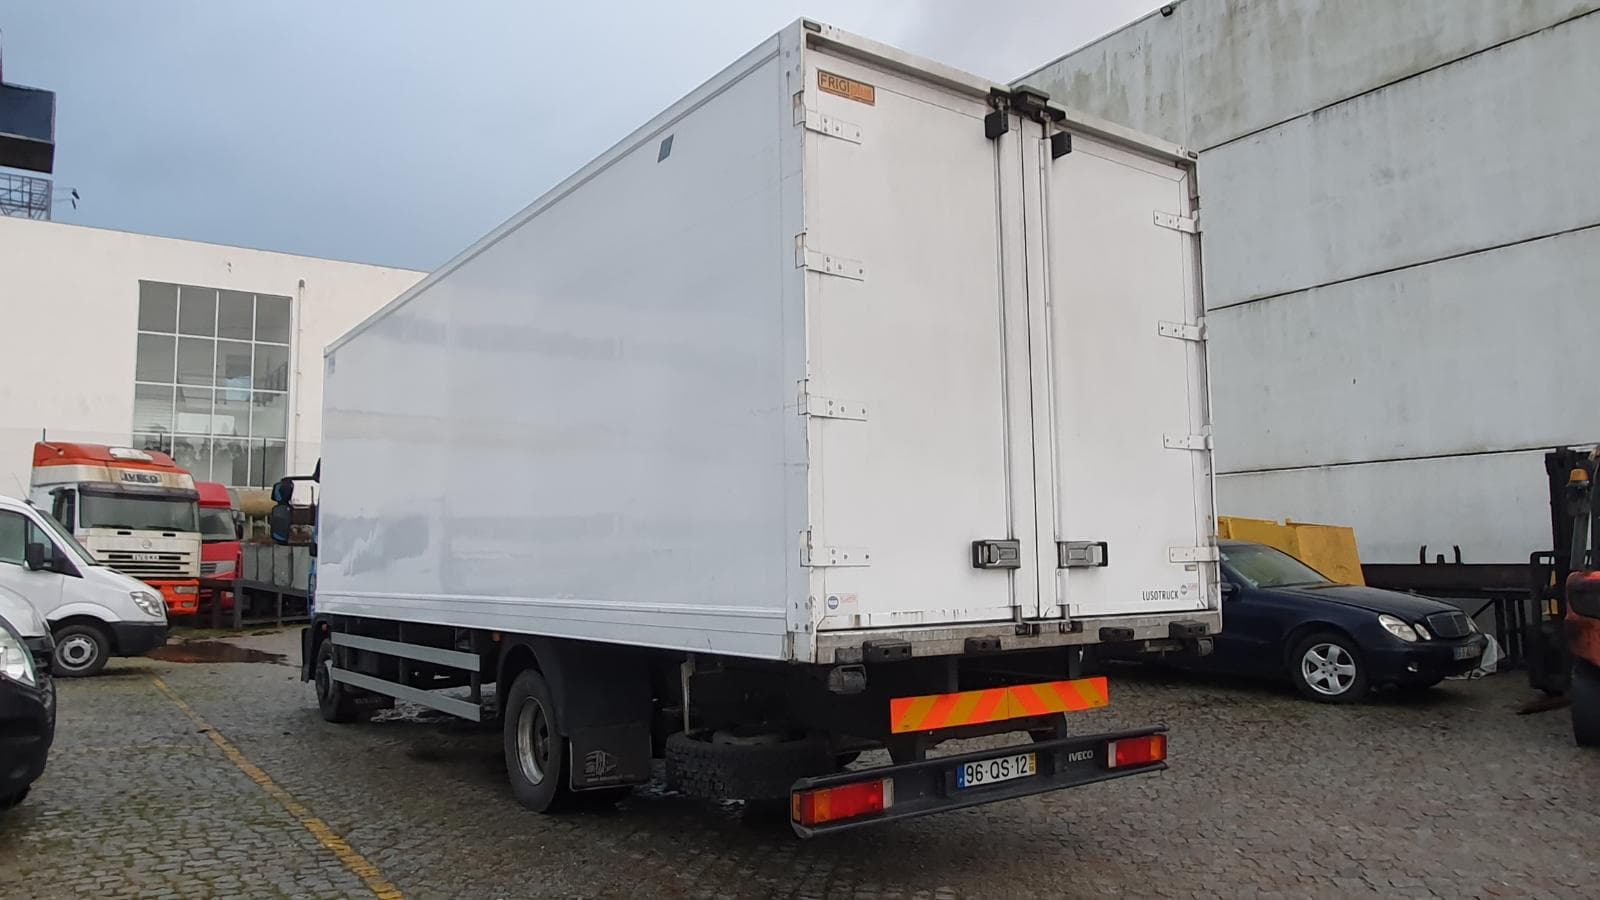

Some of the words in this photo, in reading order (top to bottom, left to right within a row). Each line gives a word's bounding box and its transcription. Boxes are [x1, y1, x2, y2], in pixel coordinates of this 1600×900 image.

[121, 472, 158, 484] IVECO
[1142, 590, 1179, 600] LUSOTRUCK
[1068, 750, 1094, 762] IVECO
